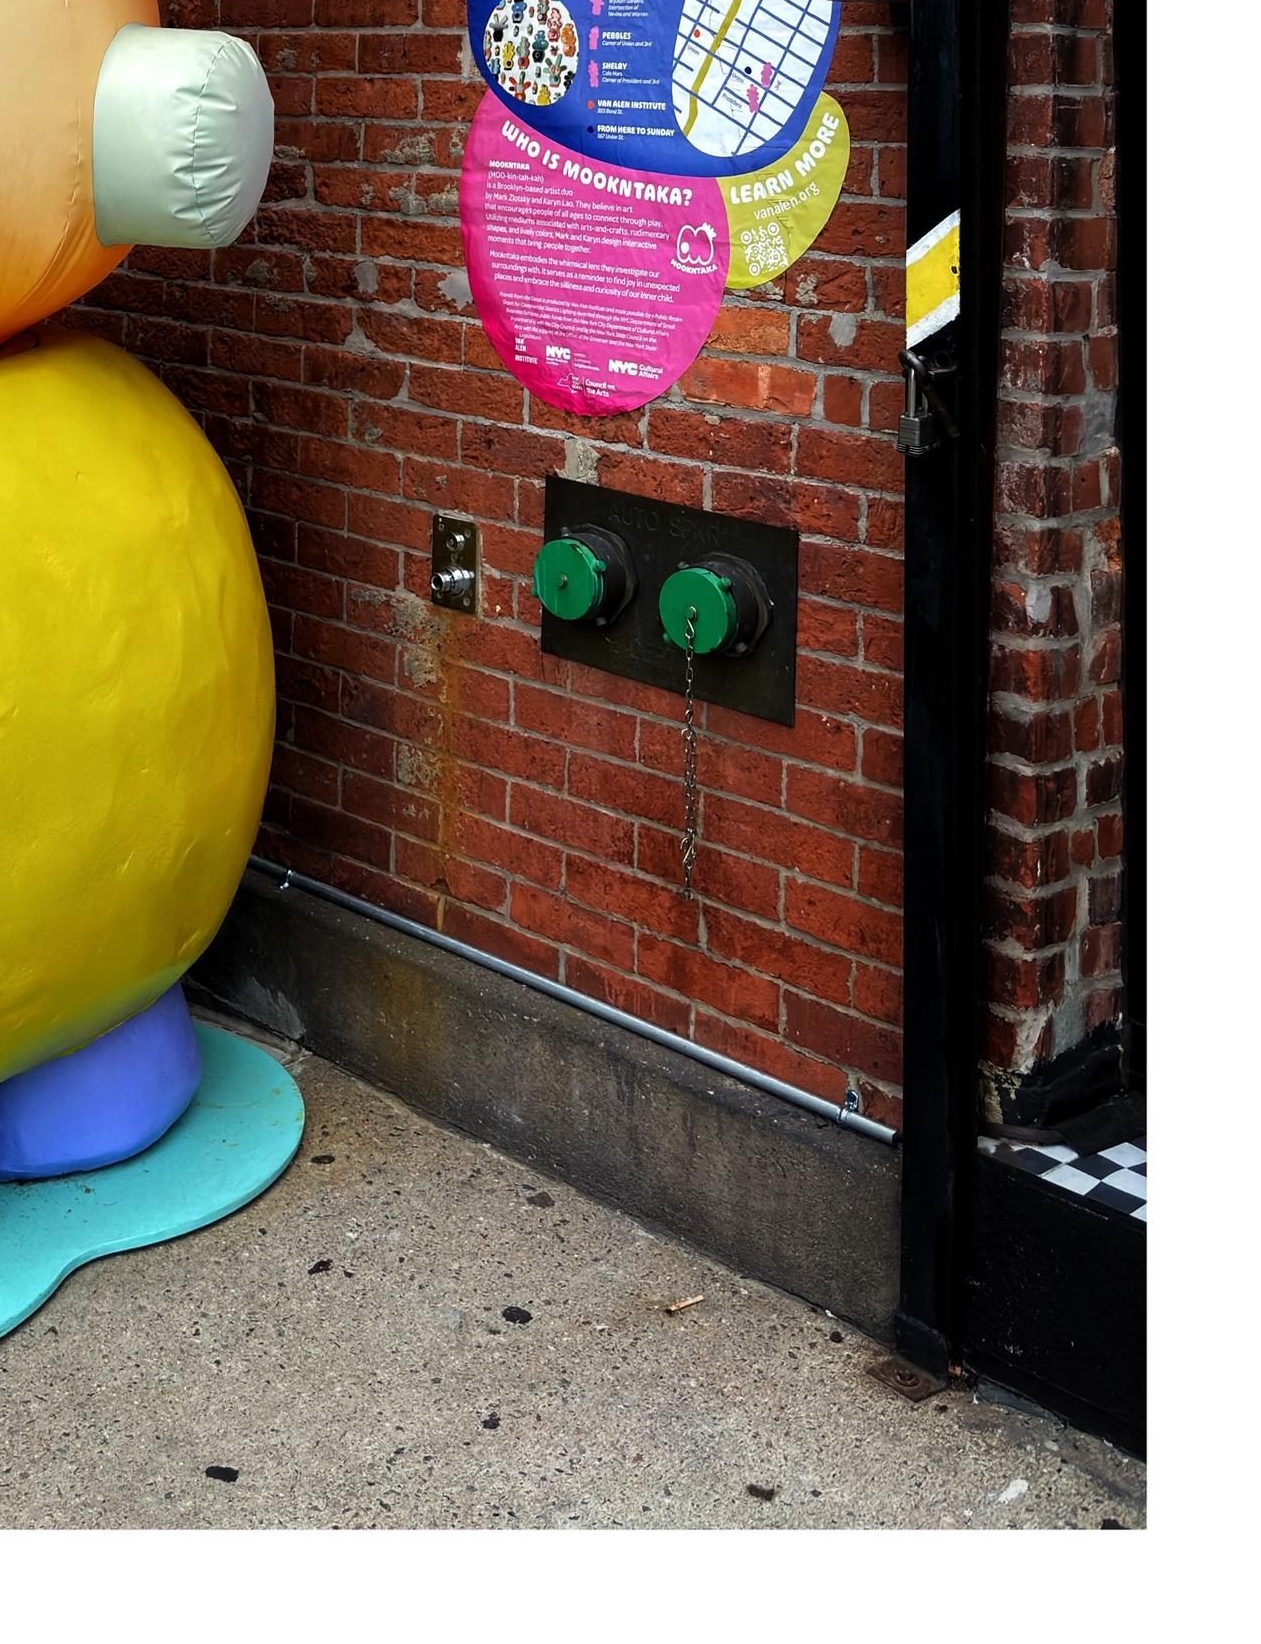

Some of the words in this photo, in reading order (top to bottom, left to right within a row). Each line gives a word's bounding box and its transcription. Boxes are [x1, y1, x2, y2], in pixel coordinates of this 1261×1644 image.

[602, 31, 632, 40] PEBBLES
[602, 62, 628, 70] SHELBY
[597, 99, 612, 108] VAN
[612, 100, 631, 109] ALEN
[631, 101, 667, 111] INSTITUTE
[597, 125, 617, 133] FROM
[618, 126, 635, 134] HERE
[635, 127, 646, 135] TO
[646, 127, 675, 137] SUNDAY
[502, 120, 541, 158] WHO
[542, 149, 560, 169] IS
[561, 163, 693, 207] MOOKNTAKA?
[730, 171, 795, 205] LEARN
[797, 110, 840, 178] MORE
[489, 159, 530, 171] MOOKNTAKA
[752, 181, 820, 221] vanalen.org
[670, 259, 718, 275] MOOKNTAKA
[545, 345, 571, 360] NYC
[608, 359, 638, 377] NYC
[639, 364, 664, 374] Cultural
[639, 371, 659, 380] Affairs
[585, 378, 607, 390] Council
[596, 388, 611, 397] Arts
